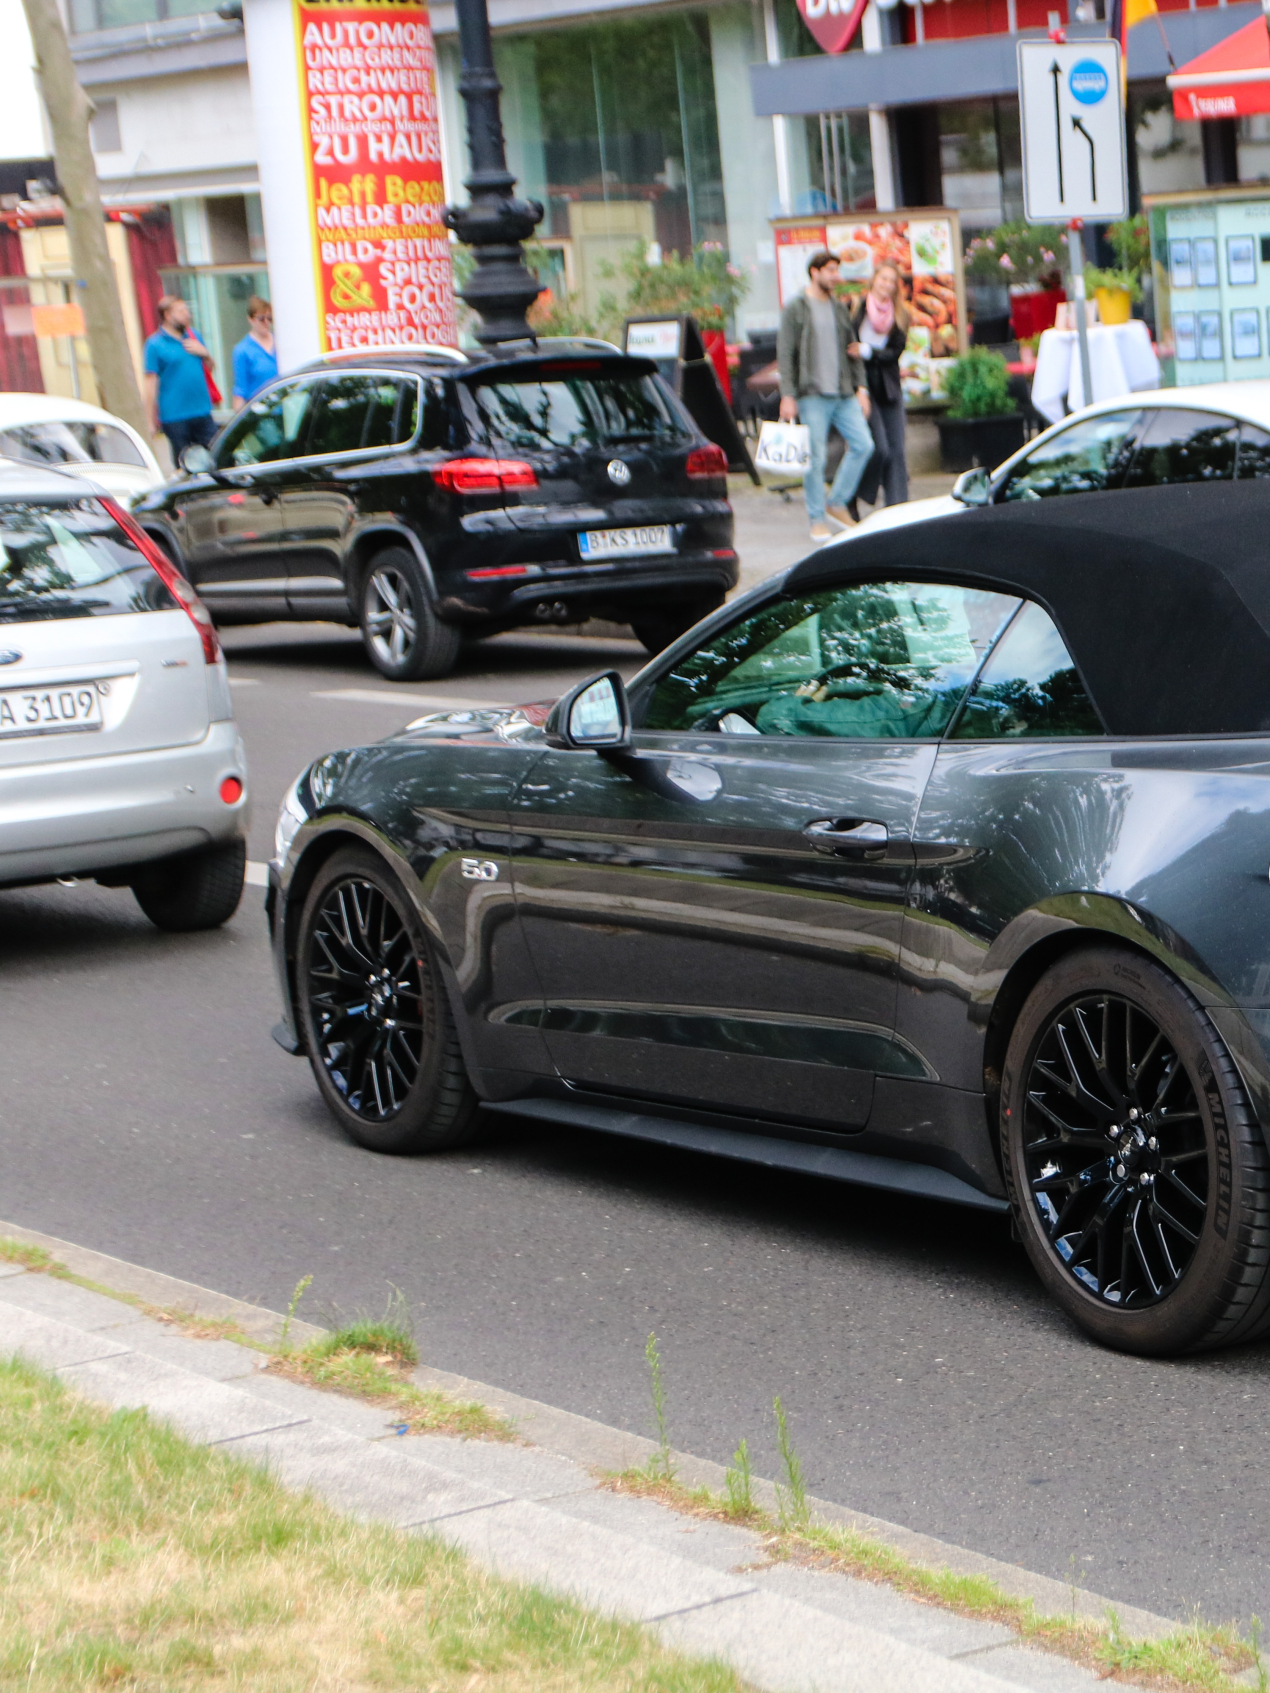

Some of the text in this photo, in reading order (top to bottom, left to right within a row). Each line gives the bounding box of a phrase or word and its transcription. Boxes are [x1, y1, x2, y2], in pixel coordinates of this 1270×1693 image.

[310, 93, 409, 121] STROM
[310, 118, 393, 135] Milliarden
[313, 134, 358, 165] ZU
[316, 173, 377, 206] Jeff
[317, 203, 398, 228] MELDE
[318, 223, 428, 241] WASHINGTON
[331, 262, 376, 310] &
[387, 284, 454, 311] FOCUS
[326, 310, 408, 330] SCHREIBT
[411, 308, 441, 325] VON
[589, 527, 665, 548] B KS 1007
[22, 689, 93, 722] 3109
[1207, 1092, 1231, 1228] MICHELIN
